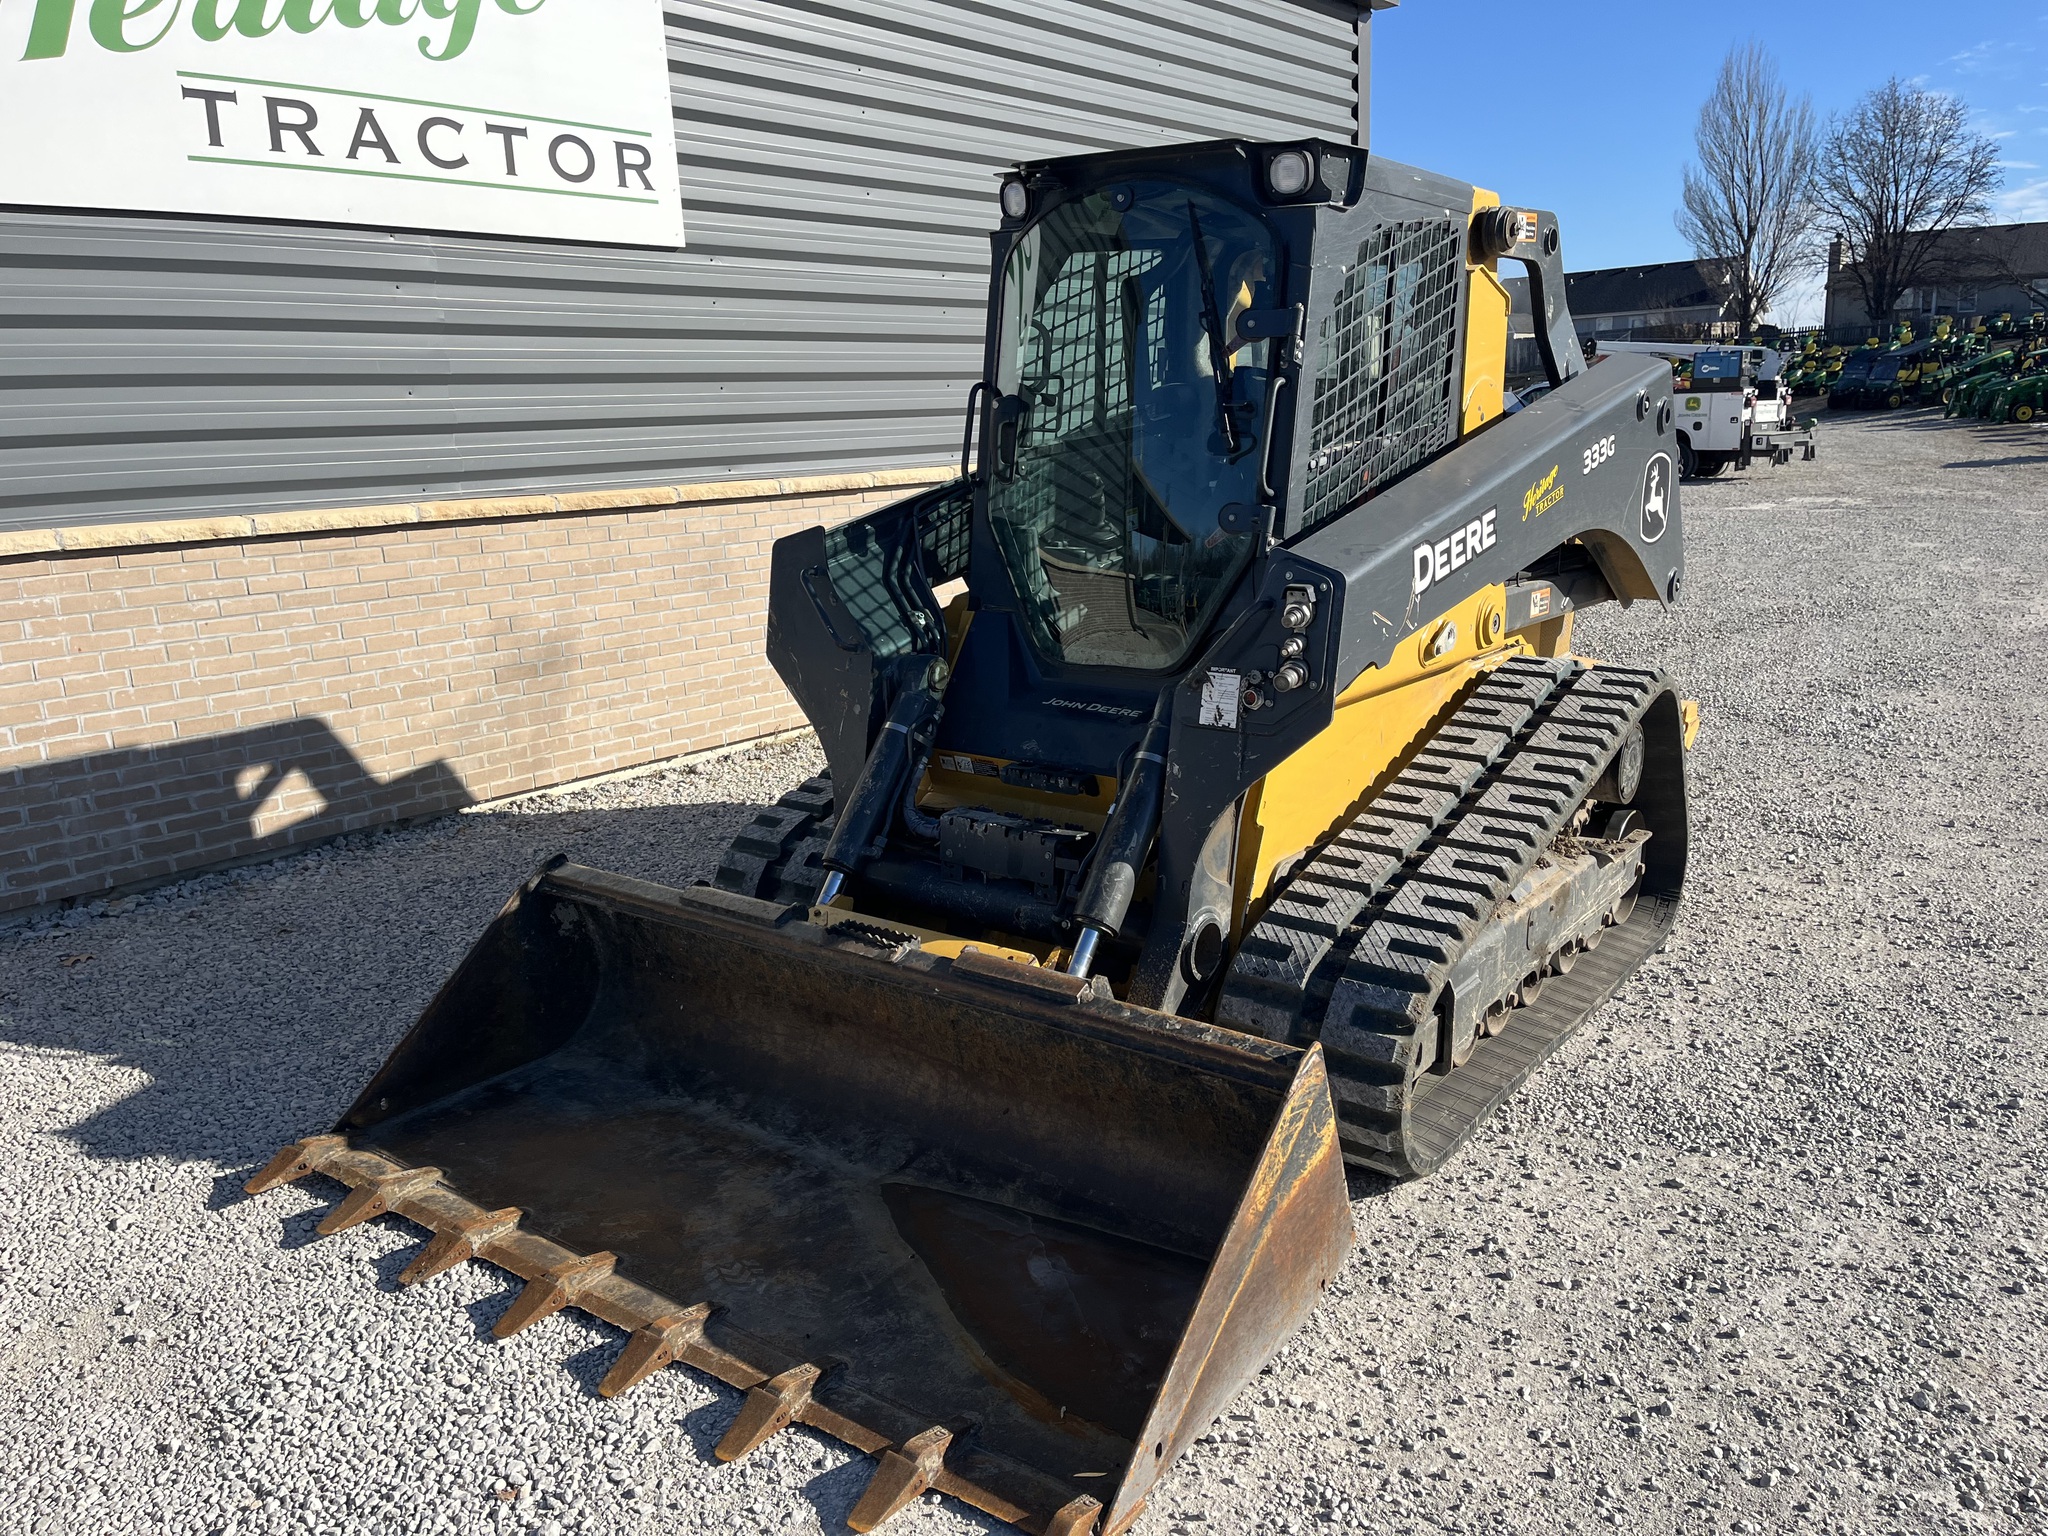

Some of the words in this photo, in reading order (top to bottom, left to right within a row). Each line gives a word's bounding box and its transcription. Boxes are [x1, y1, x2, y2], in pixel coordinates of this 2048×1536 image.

[181, 84, 656, 191] TRACTOR
[1583, 434, 1615, 475] 333G
[1522, 464, 1559, 522] Heritage
[1535, 487, 1564, 515] TRACTOR
[1413, 508, 1497, 595] DEERE
[1042, 698, 1087, 709] JOHN
[1086, 703, 1143, 717] DEERE
